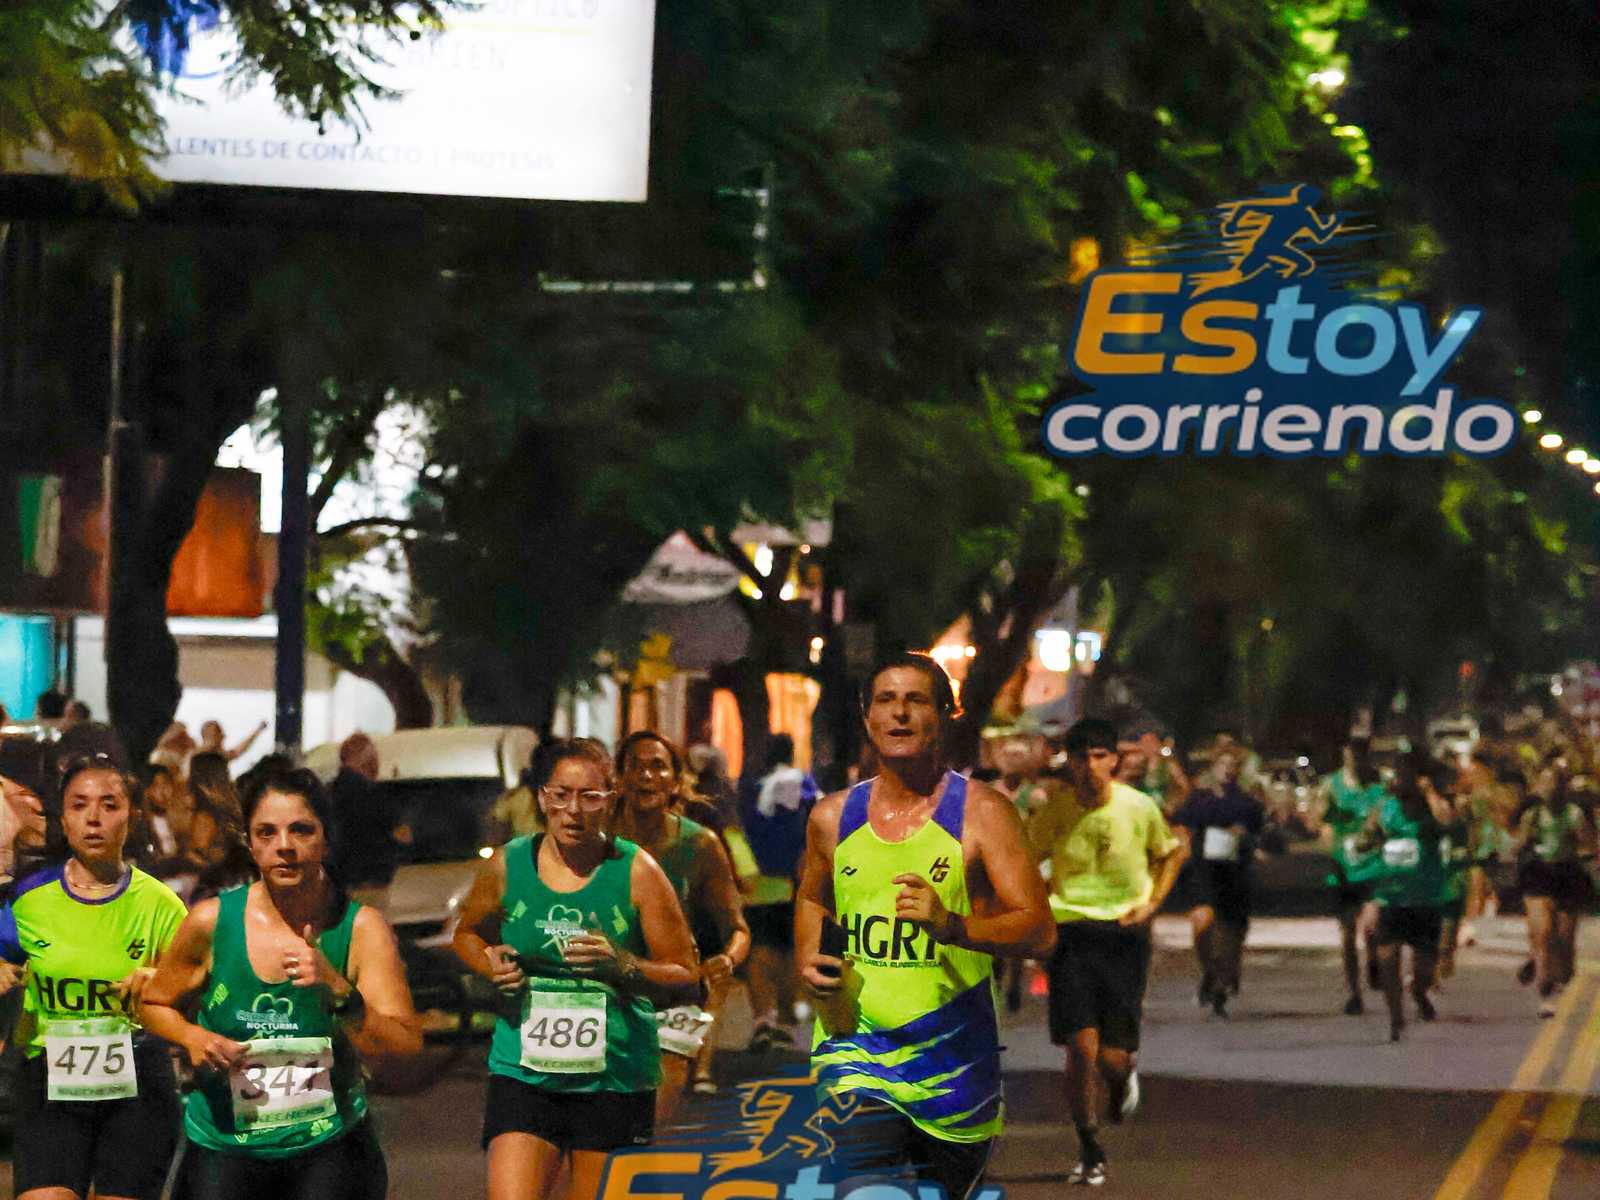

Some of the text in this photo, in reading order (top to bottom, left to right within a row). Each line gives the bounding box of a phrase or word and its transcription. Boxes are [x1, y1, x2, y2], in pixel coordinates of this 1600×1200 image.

[176, 137, 256, 159] LENTES
[263, 141, 289, 159] DE
[298, 143, 422, 166] CONTACTO
[527, 1016, 600, 1049] 486
[54, 1041, 125, 1076] 475
